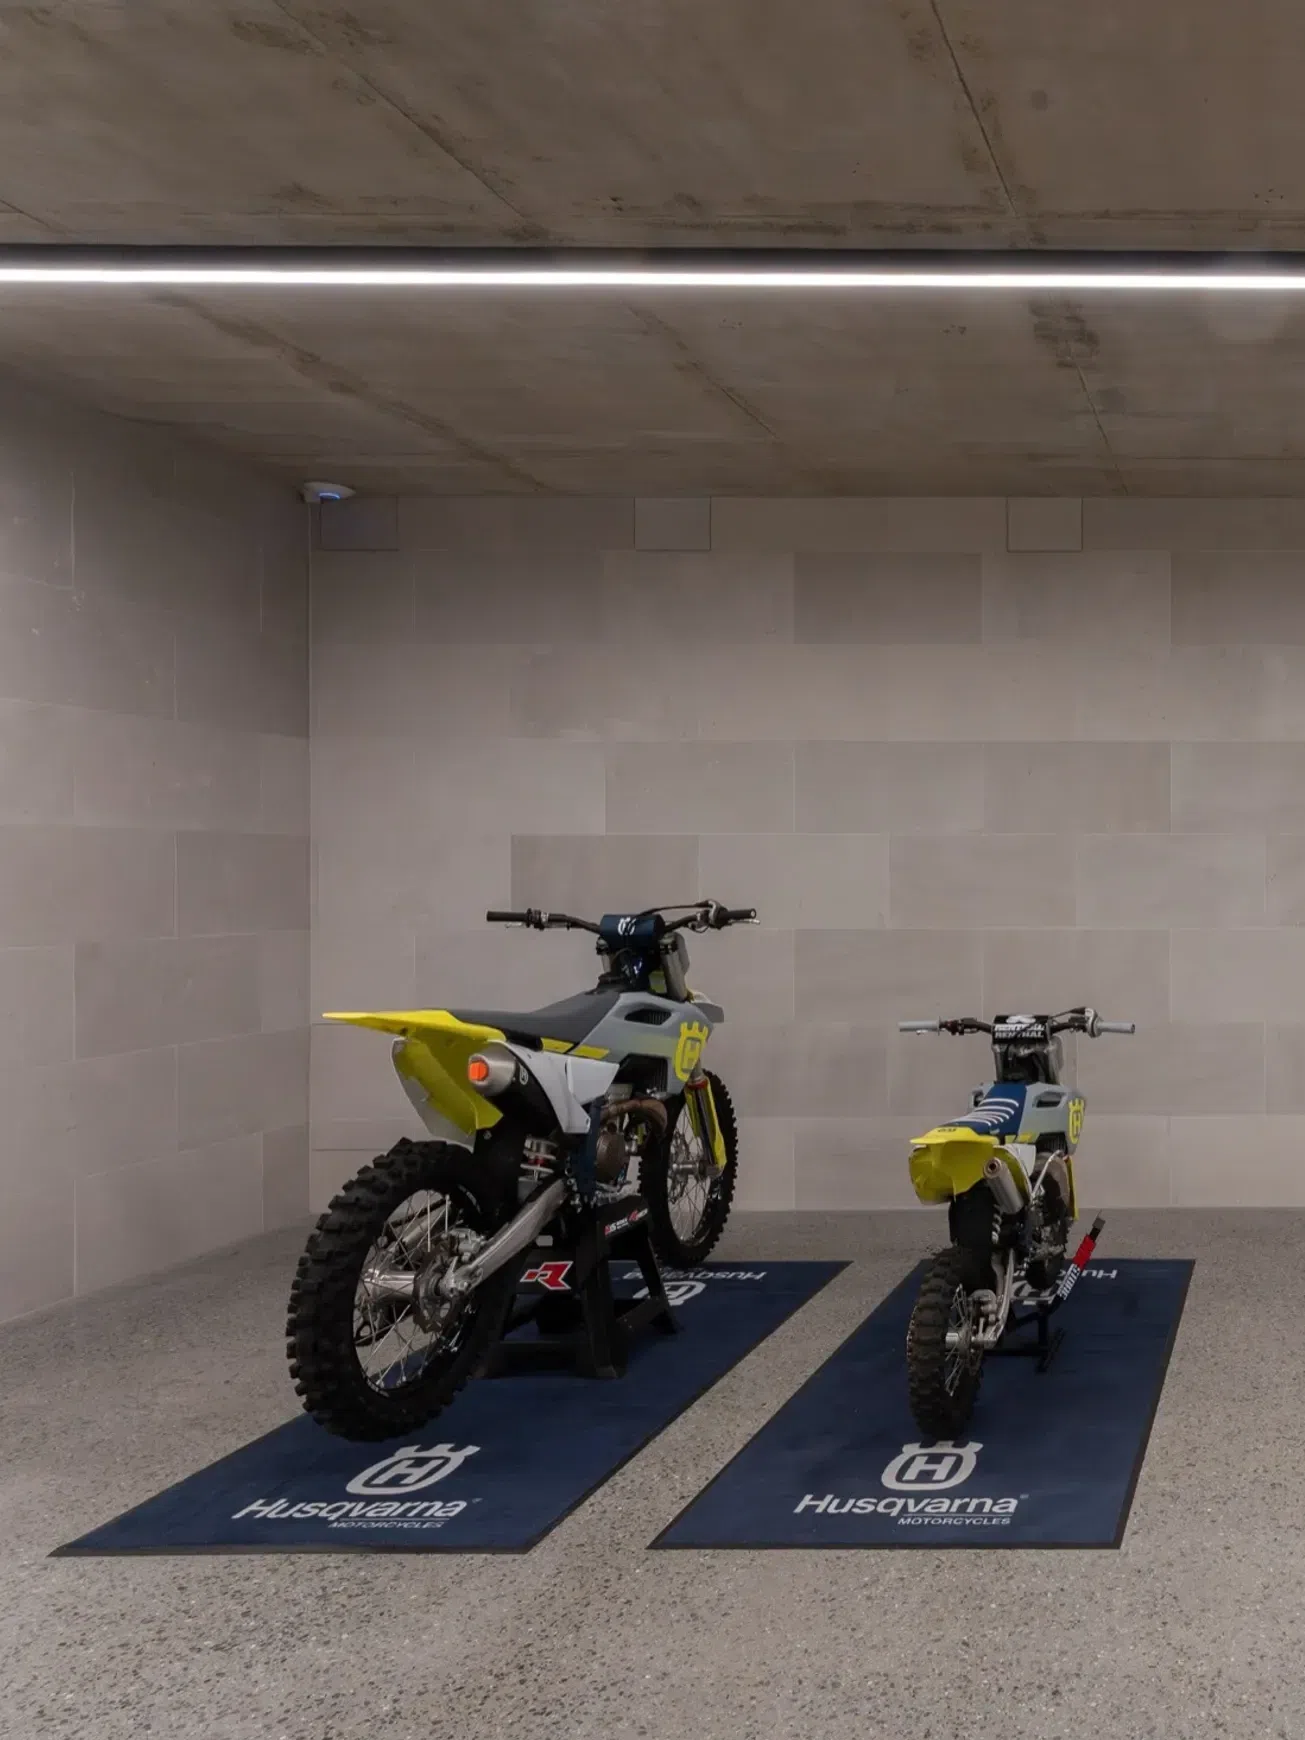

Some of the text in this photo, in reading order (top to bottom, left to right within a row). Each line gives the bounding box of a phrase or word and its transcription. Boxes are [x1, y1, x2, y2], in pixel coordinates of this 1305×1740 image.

[231, 1498, 468, 1520] Husqvarna
[793, 1494, 1019, 1517] Husqvarna
[327, 1521, 445, 1529] MOTORCYCLES
[897, 1517, 1012, 1525] MOTORCYCLES
